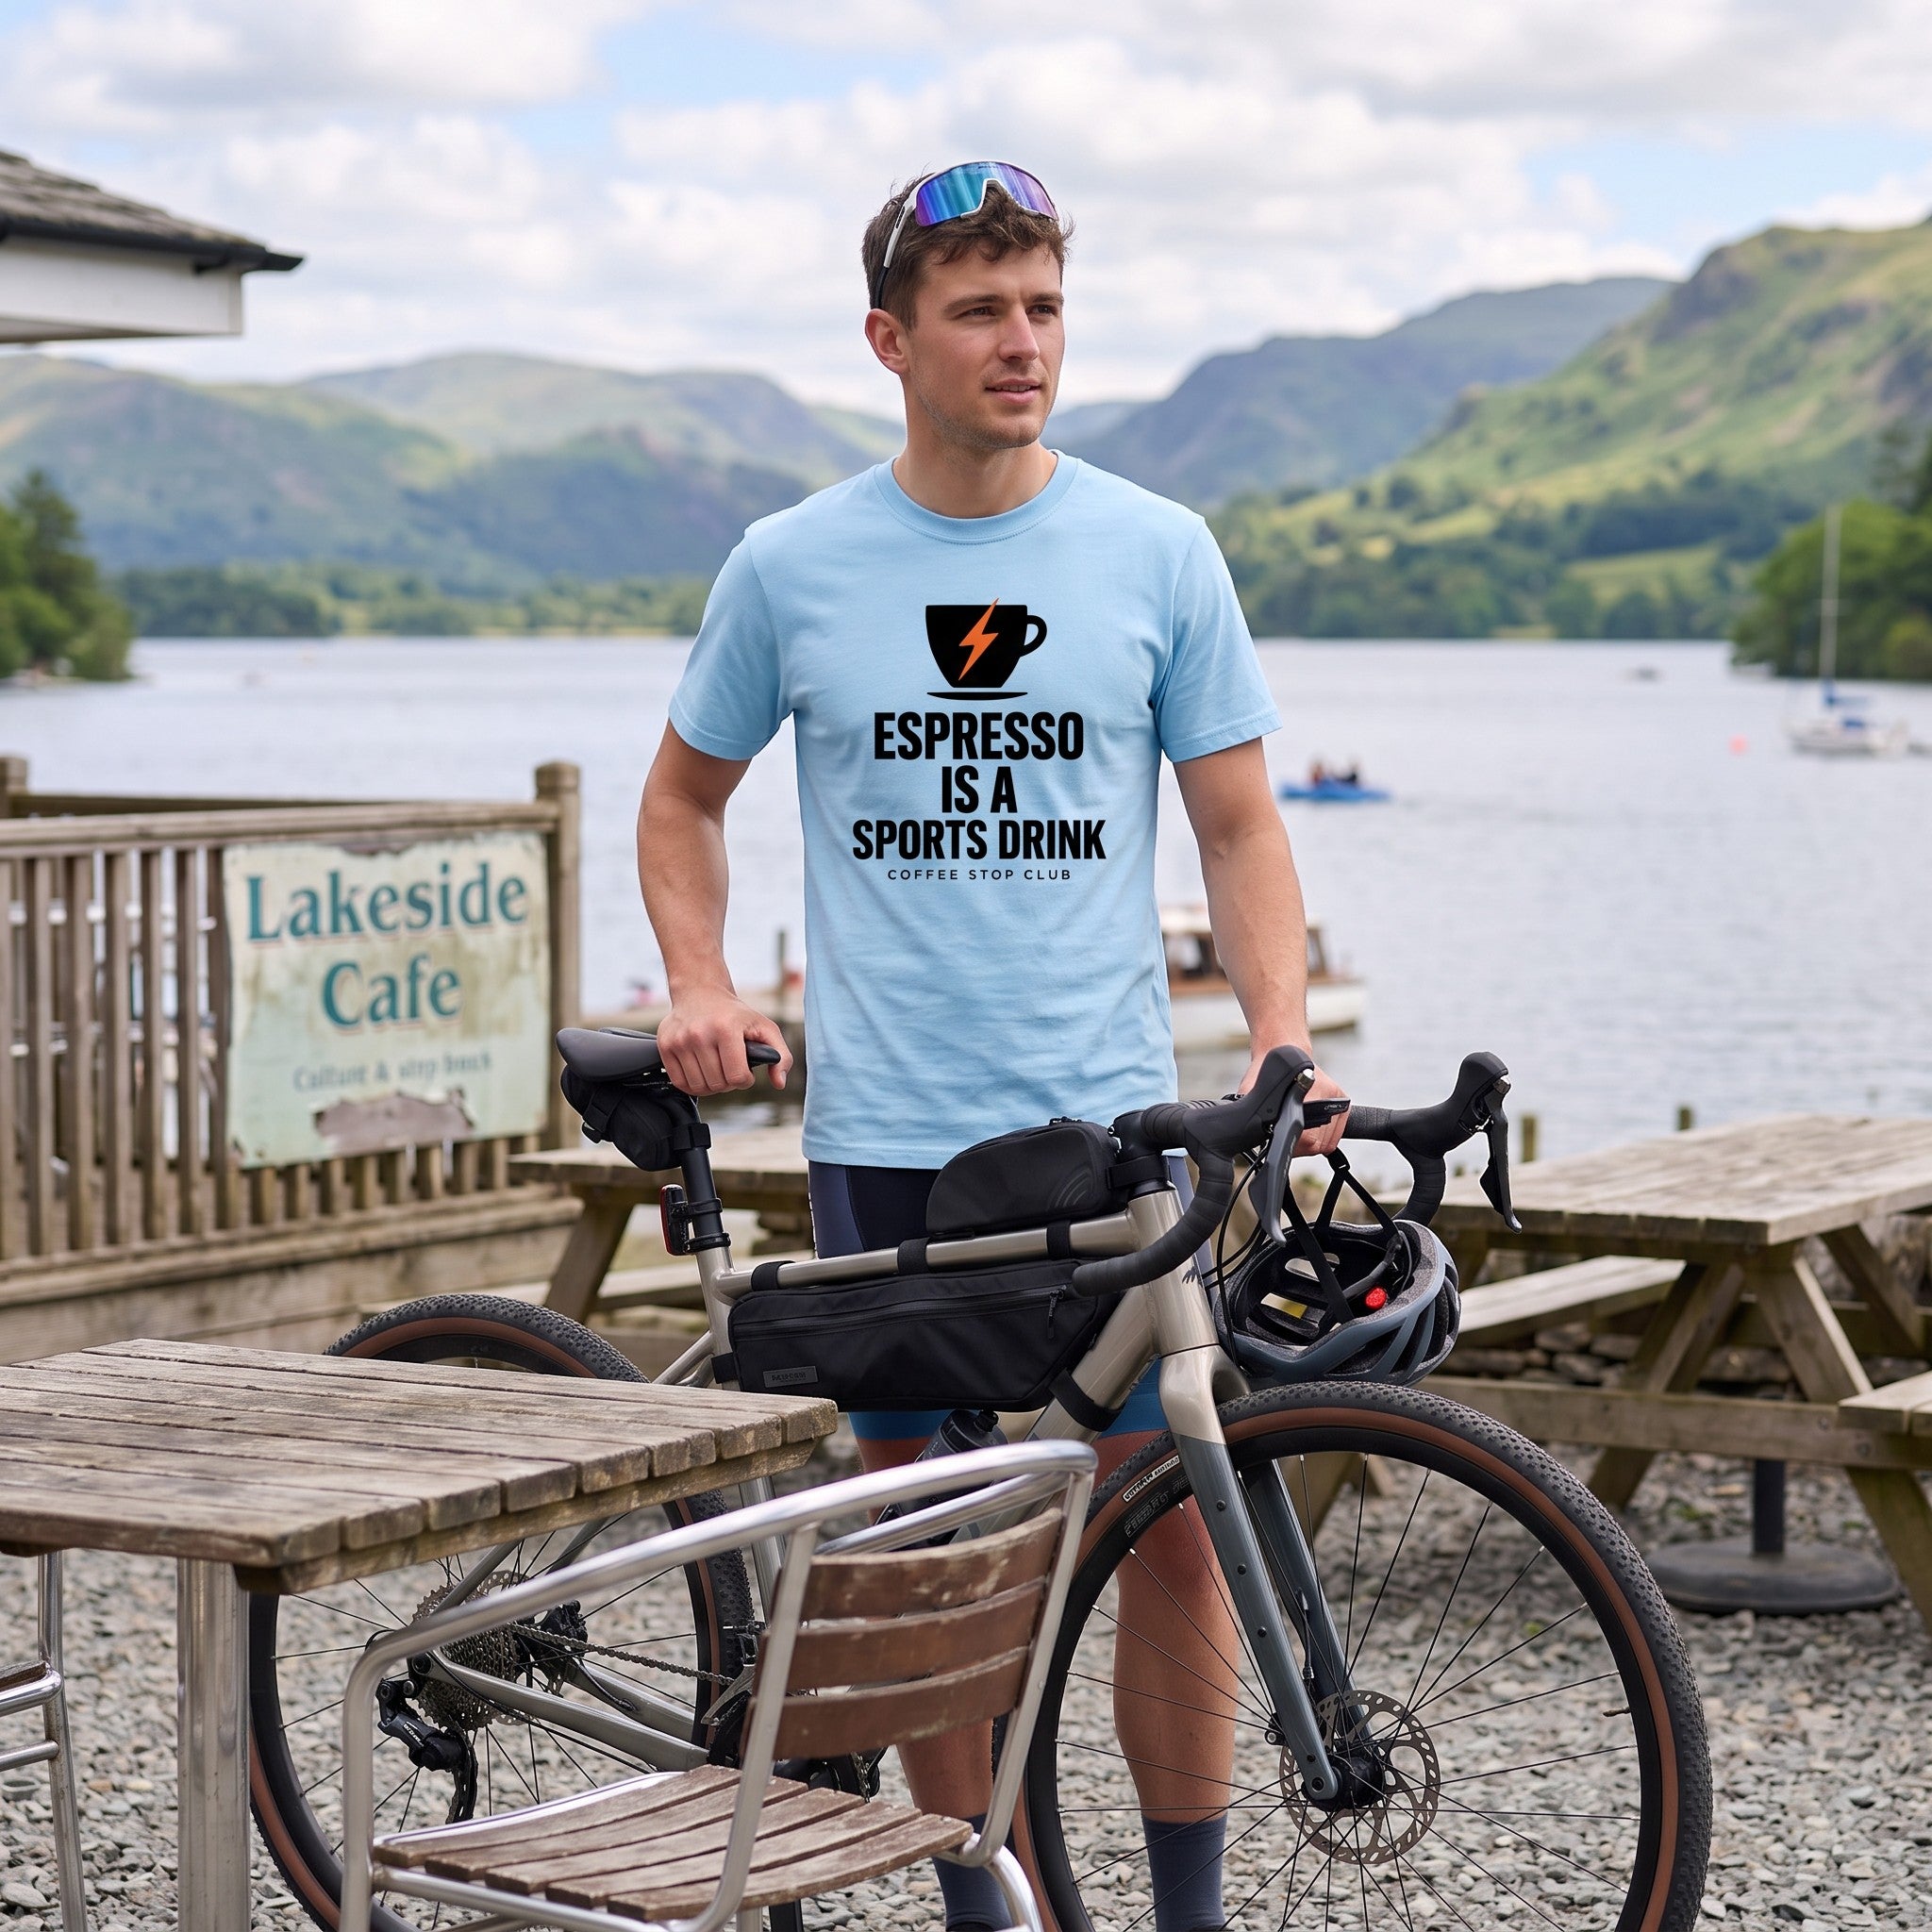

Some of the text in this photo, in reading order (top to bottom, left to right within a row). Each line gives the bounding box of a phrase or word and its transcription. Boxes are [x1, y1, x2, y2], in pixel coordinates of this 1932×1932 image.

[874, 711, 1084, 760] ESPRESSO
[941, 765, 1018, 814] IS A
[852, 819, 1107, 860] SPORTS DRINK
[887, 869, 1071, 880] COFFEE STOP CLUB
[246, 861, 527, 941] Lakeside
[321, 953, 461, 1028] Cafe
